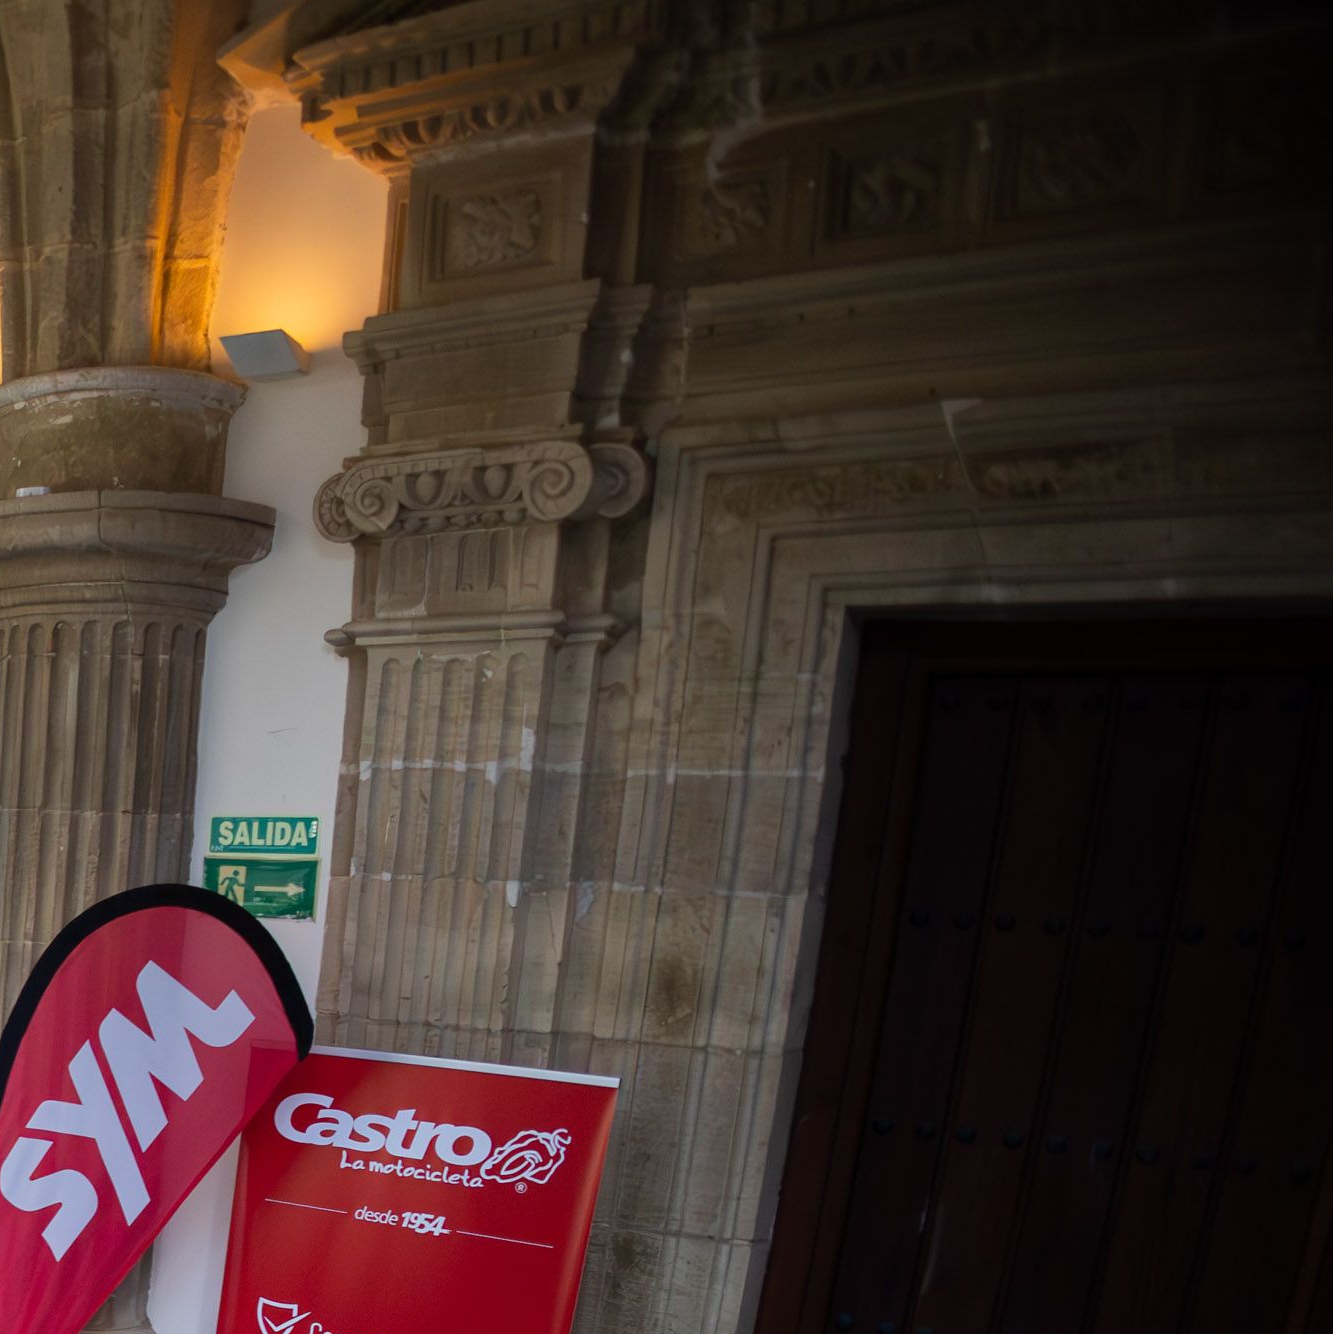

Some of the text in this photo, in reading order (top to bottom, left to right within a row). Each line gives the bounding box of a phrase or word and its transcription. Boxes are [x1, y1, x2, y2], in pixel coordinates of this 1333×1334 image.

[218, 821, 308, 846] SALIDA
[0, 959, 256, 1263] SYM
[274, 1092, 492, 1167] Castro
[340, 1150, 484, 1188] La motocicleta
[354, 1206, 453, 1236] desde 1954
